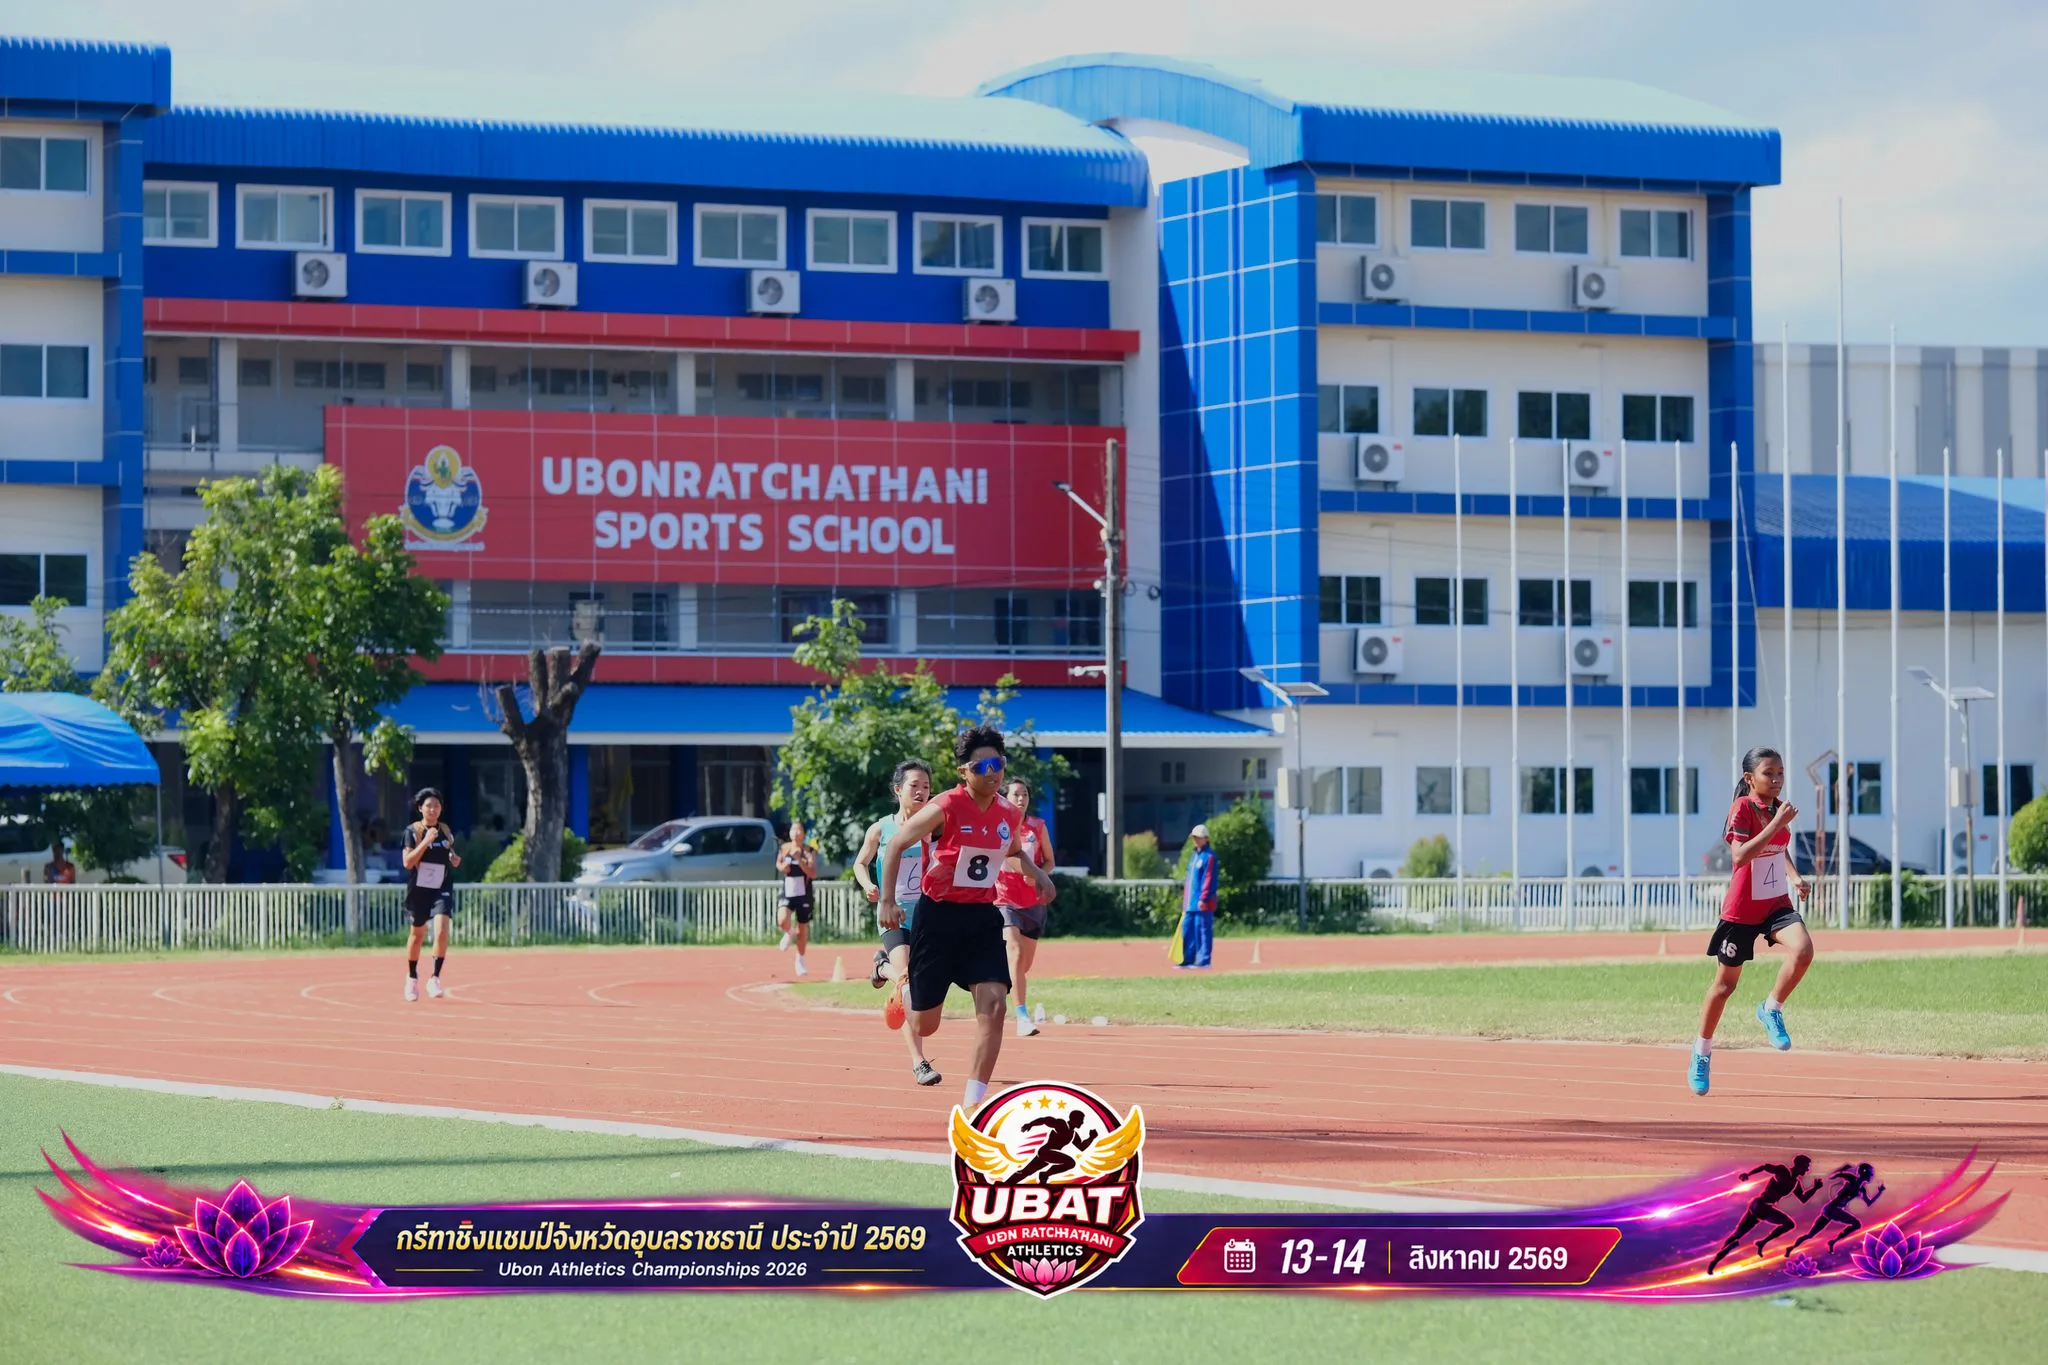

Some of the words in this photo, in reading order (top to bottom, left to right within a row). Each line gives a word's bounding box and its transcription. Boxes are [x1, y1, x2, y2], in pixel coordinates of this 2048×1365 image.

[542, 456, 988, 504] UBONRATCHATHANI
[594, 511, 764, 551] SPORTS
[788, 514, 956, 554] SCHOOL
[907, 862, 921, 891] 6
[967, 855, 990, 881] 8
[1763, 862, 1778, 889] 4
